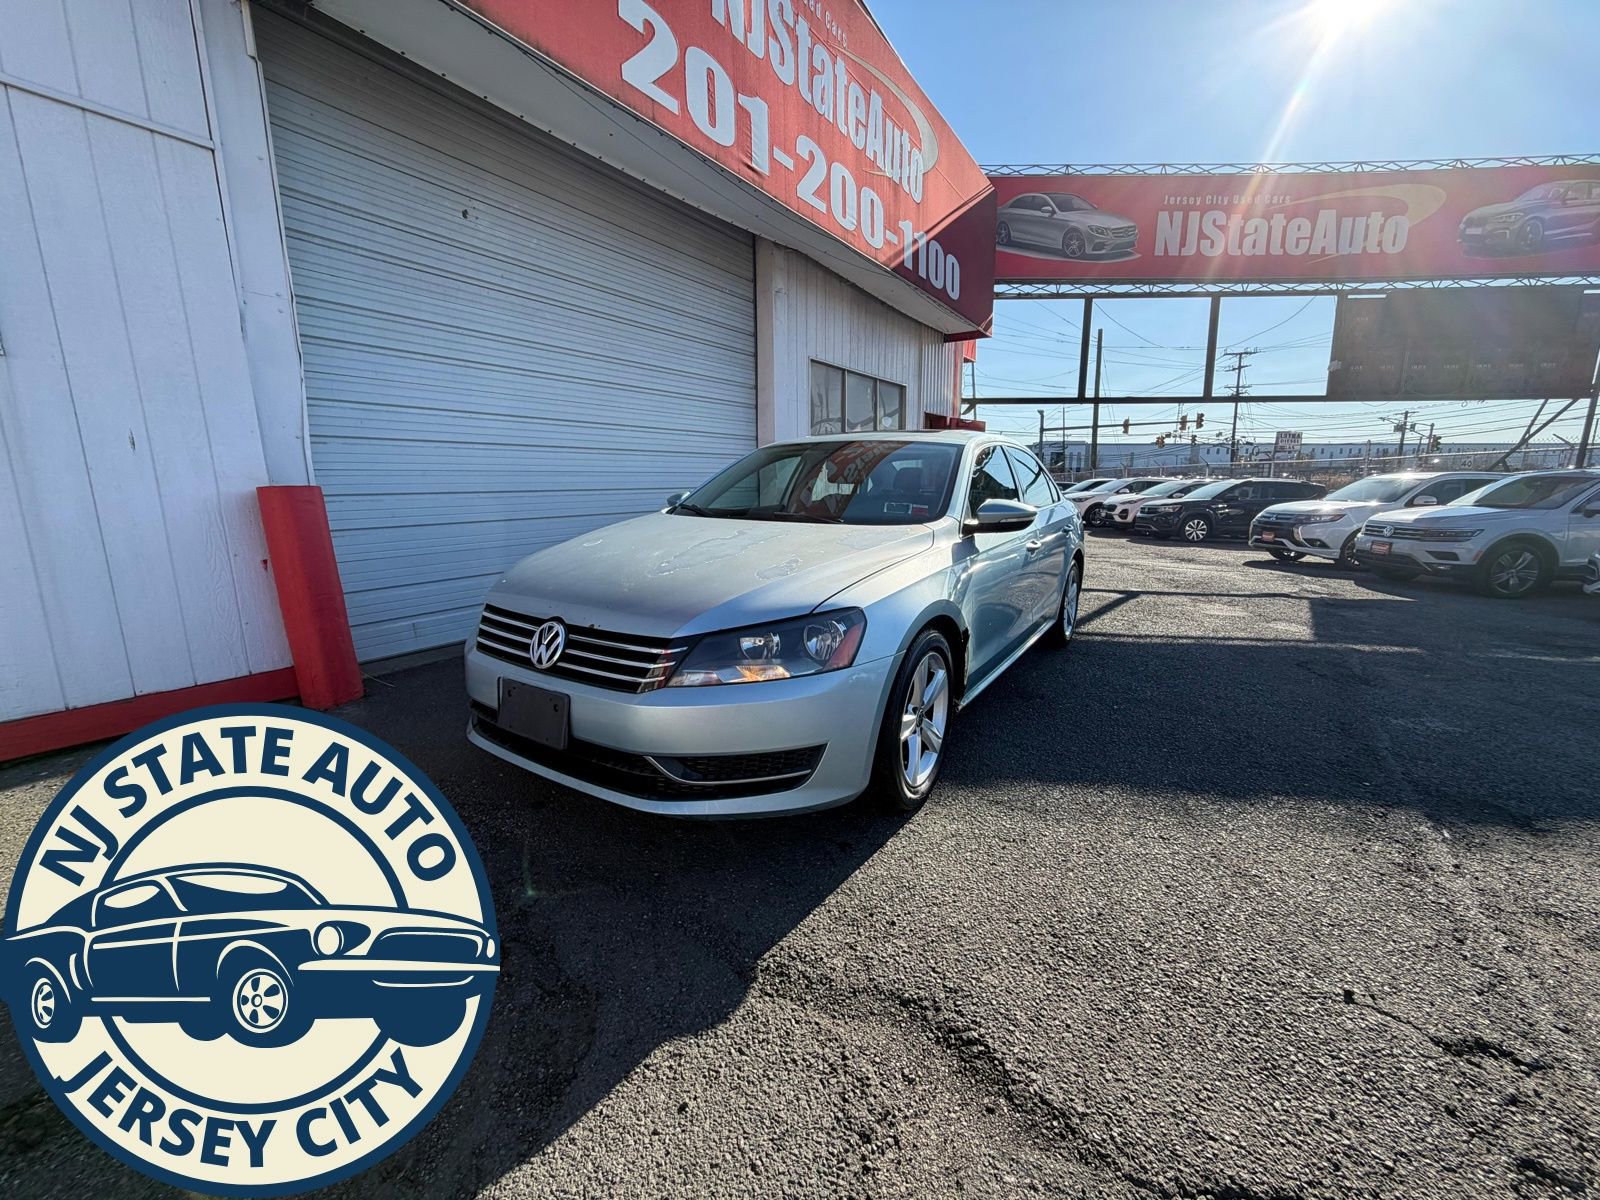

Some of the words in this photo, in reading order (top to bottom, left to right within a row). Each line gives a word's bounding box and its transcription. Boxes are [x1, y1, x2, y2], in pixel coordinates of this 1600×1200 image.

[618, 0, 961, 300] 201-200-1100
[1163, 195, 1201, 207] Jersey
[1205, 195, 1229, 206] City
[1263, 194, 1291, 205] Cars
[1154, 209, 1409, 257] NJStateAuto
